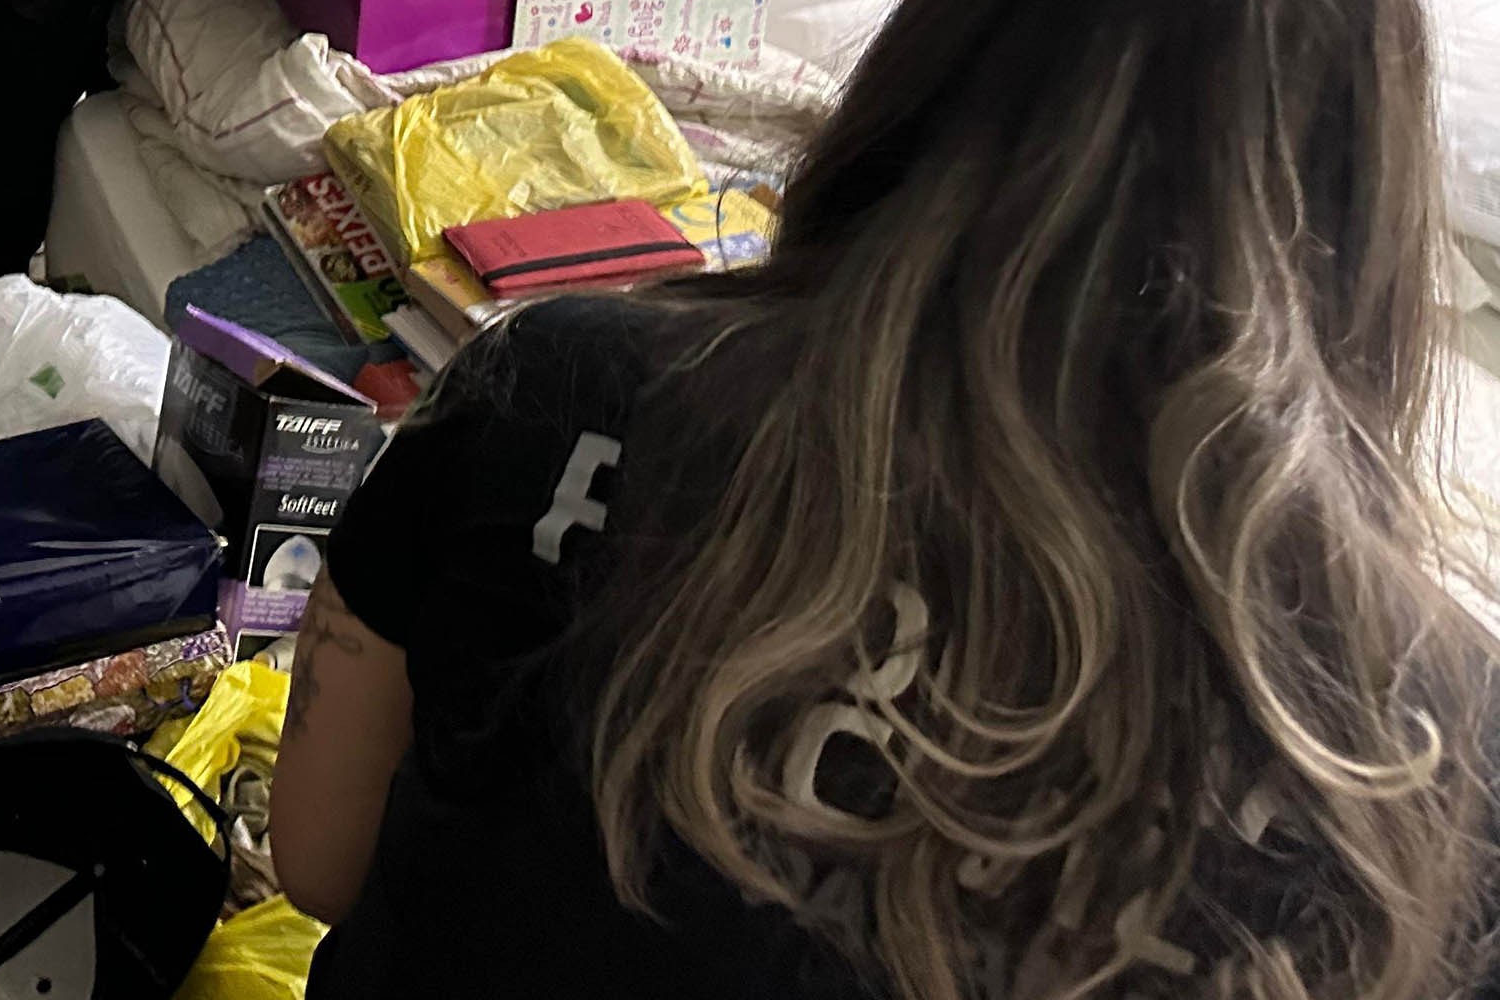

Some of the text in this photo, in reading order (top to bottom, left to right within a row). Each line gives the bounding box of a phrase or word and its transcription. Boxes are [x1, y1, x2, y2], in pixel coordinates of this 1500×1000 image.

[306, 174, 387, 275] PEIXES
[274, 413, 343, 435] TAIFF
[278, 492, 339, 517] SoftFeet
